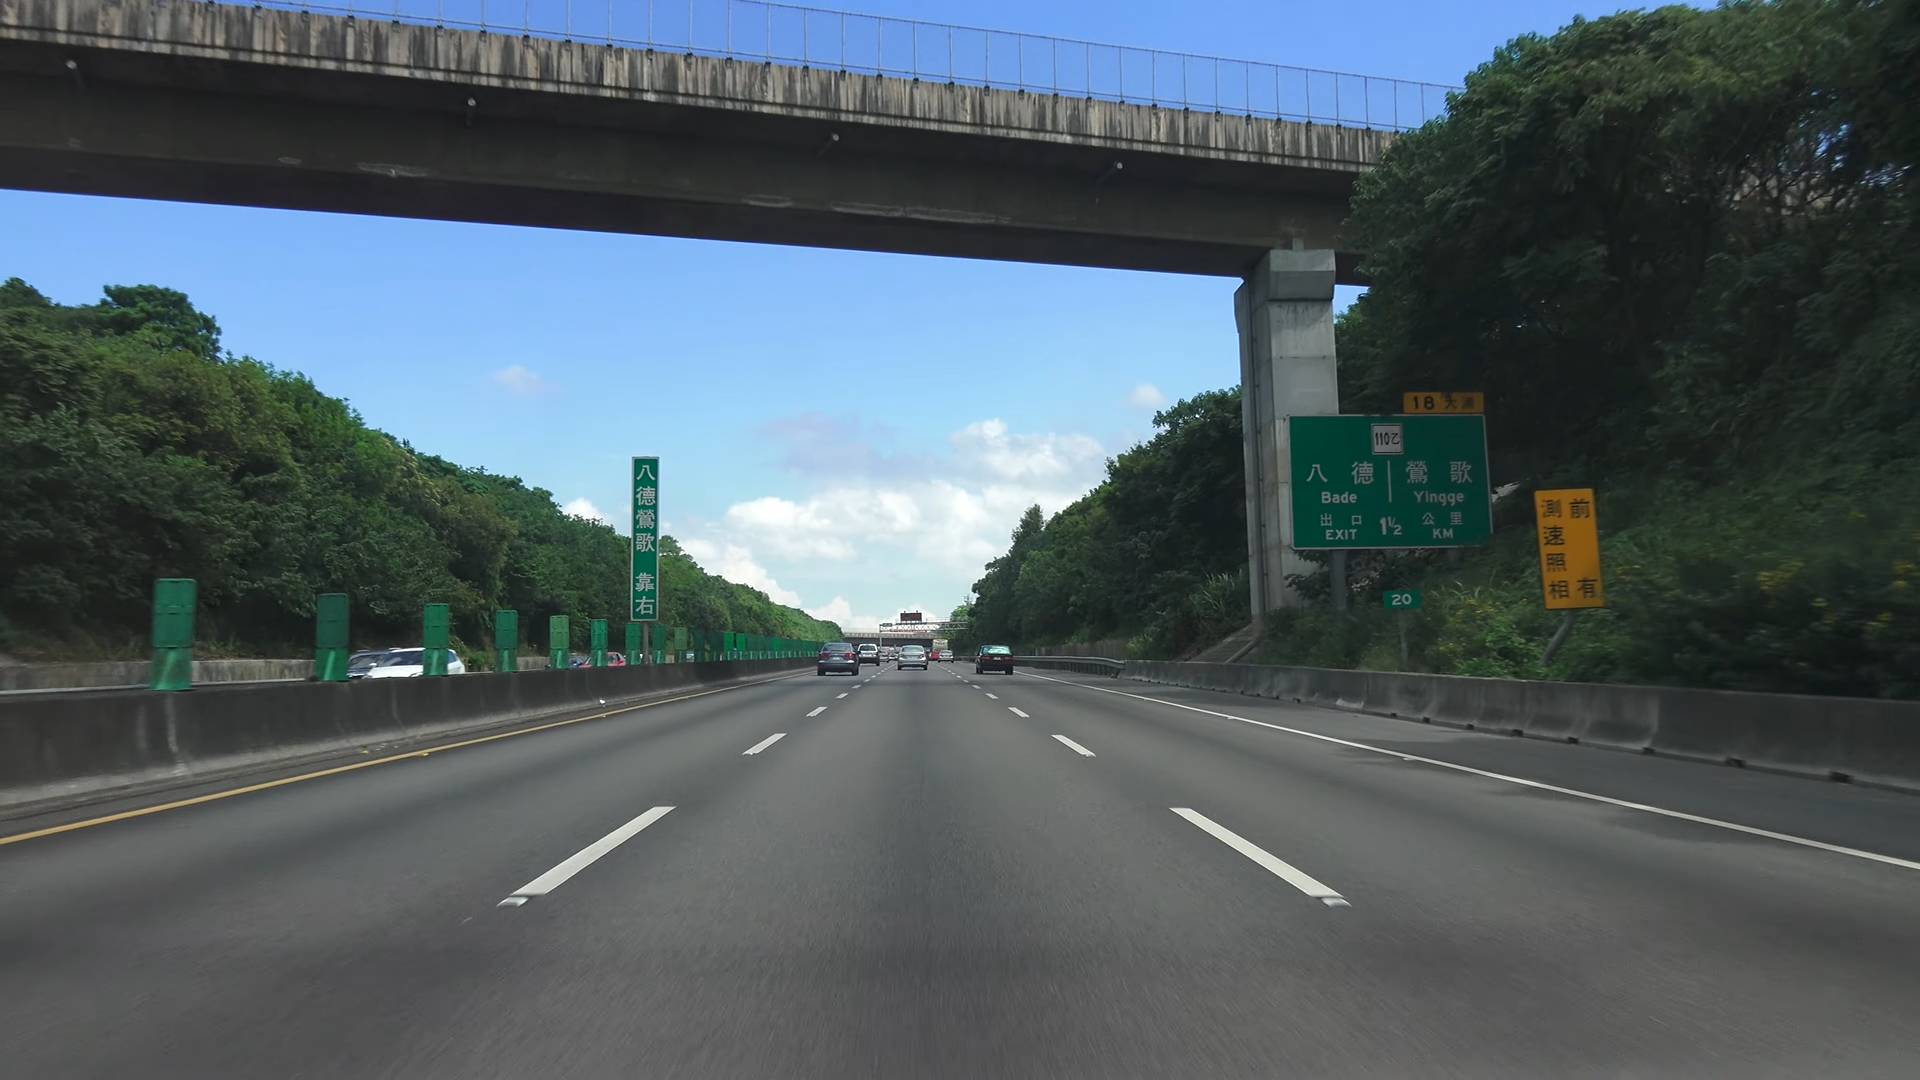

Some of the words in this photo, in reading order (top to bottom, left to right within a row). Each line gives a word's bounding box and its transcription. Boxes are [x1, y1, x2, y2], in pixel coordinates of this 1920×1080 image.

[1413, 395, 1434, 410] 18
[1374, 432, 1400, 446] 110乙
[1306, 461, 1375, 485] 八德
[1405, 460, 1473, 485] 鶯歌
[1320, 491, 1357, 504] Bade
[1413, 490, 1465, 506] Yingge
[635, 464, 656, 553] 八德鶯歌
[1320, 513, 1362, 527] 出口
[1421, 512, 1464, 526] 公里
[1325, 529, 1358, 541] EXIT
[1432, 528, 1454, 539] KM
[635, 572, 655, 615] 靠右
[1391, 593, 1412, 606] 20
